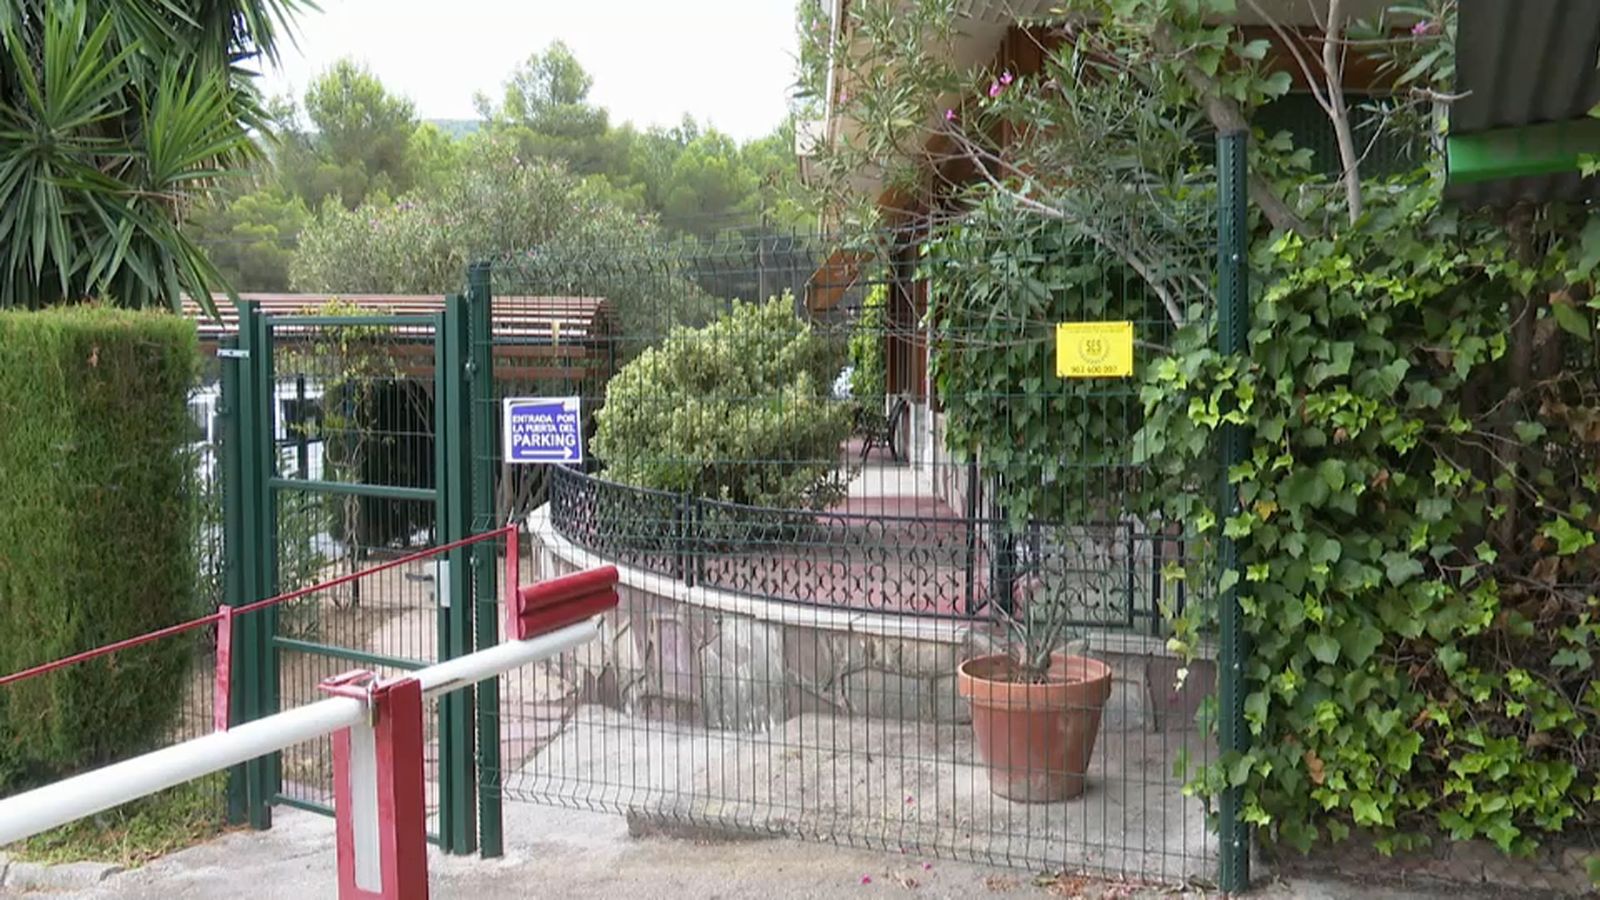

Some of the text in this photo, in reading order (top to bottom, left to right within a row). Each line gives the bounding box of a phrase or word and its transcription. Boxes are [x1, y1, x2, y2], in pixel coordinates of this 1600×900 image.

[512, 414, 575, 423] ENTRADA POR
[512, 424, 575, 433] LA PUERTA DEL
[513, 434, 576, 447] PARKING
